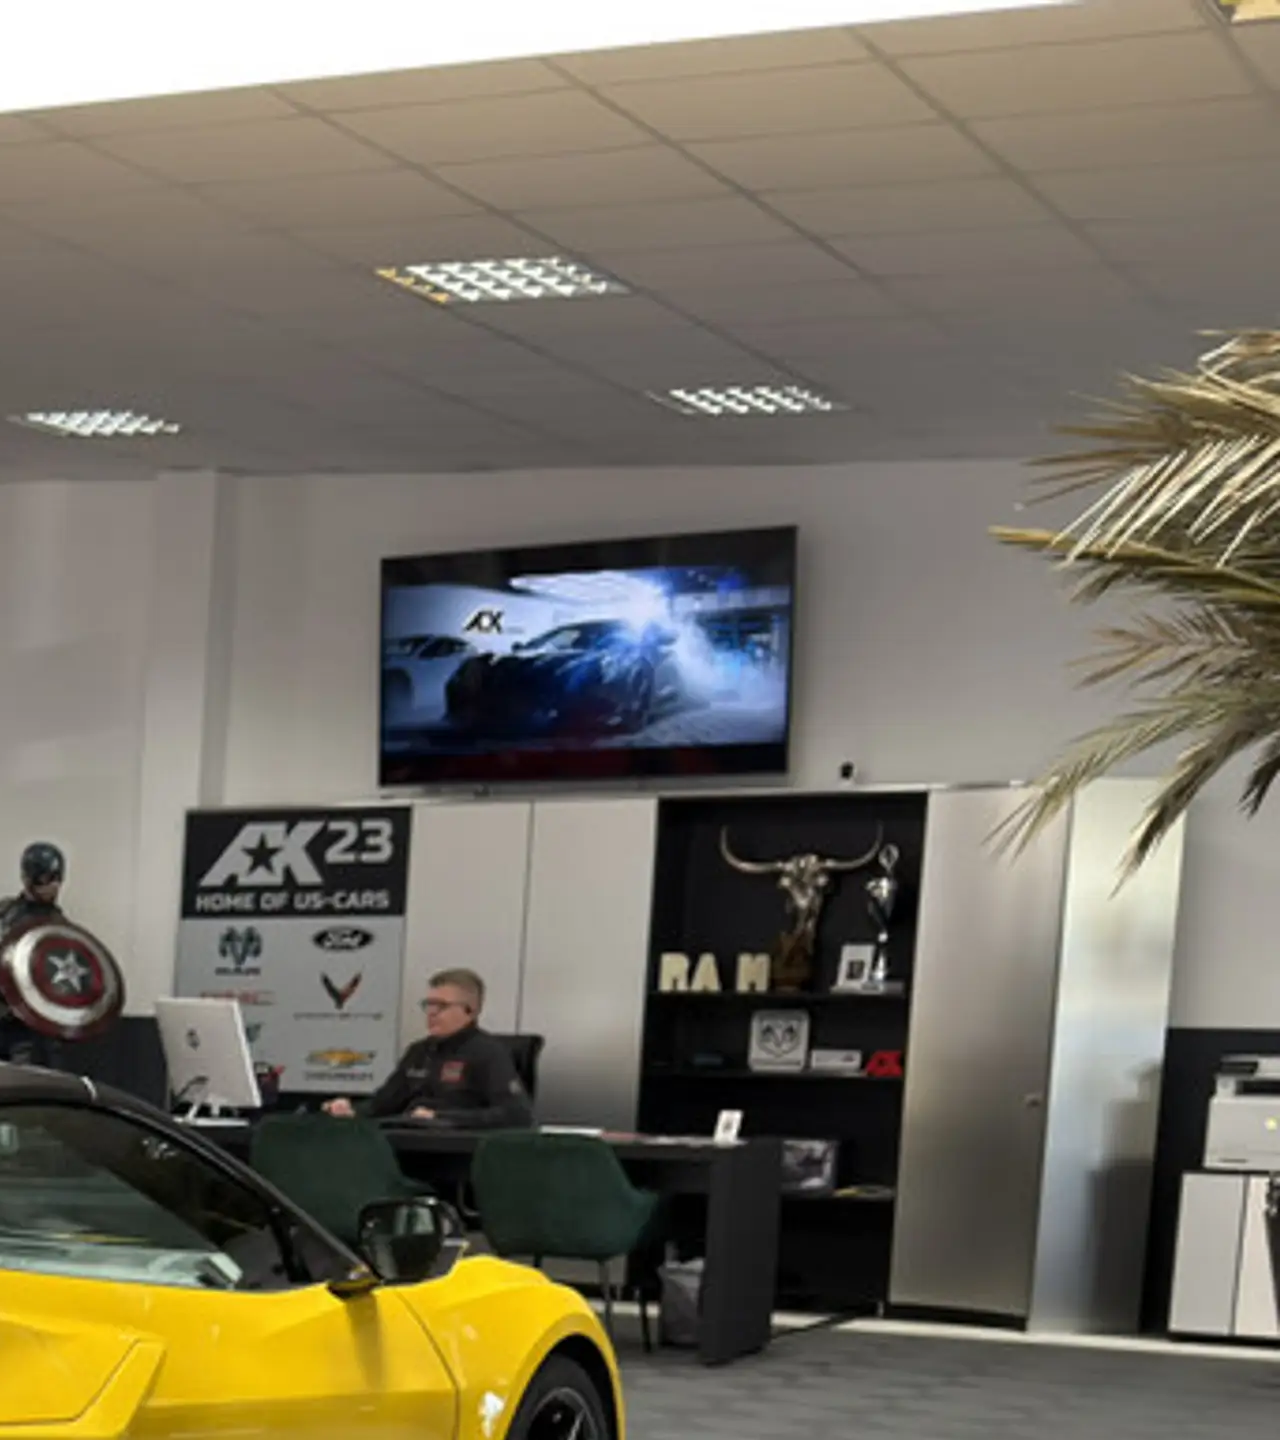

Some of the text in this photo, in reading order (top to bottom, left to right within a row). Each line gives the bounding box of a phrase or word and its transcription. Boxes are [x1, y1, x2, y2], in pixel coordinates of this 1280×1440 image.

[196, 889, 390, 911] HOME OF US-CARS
